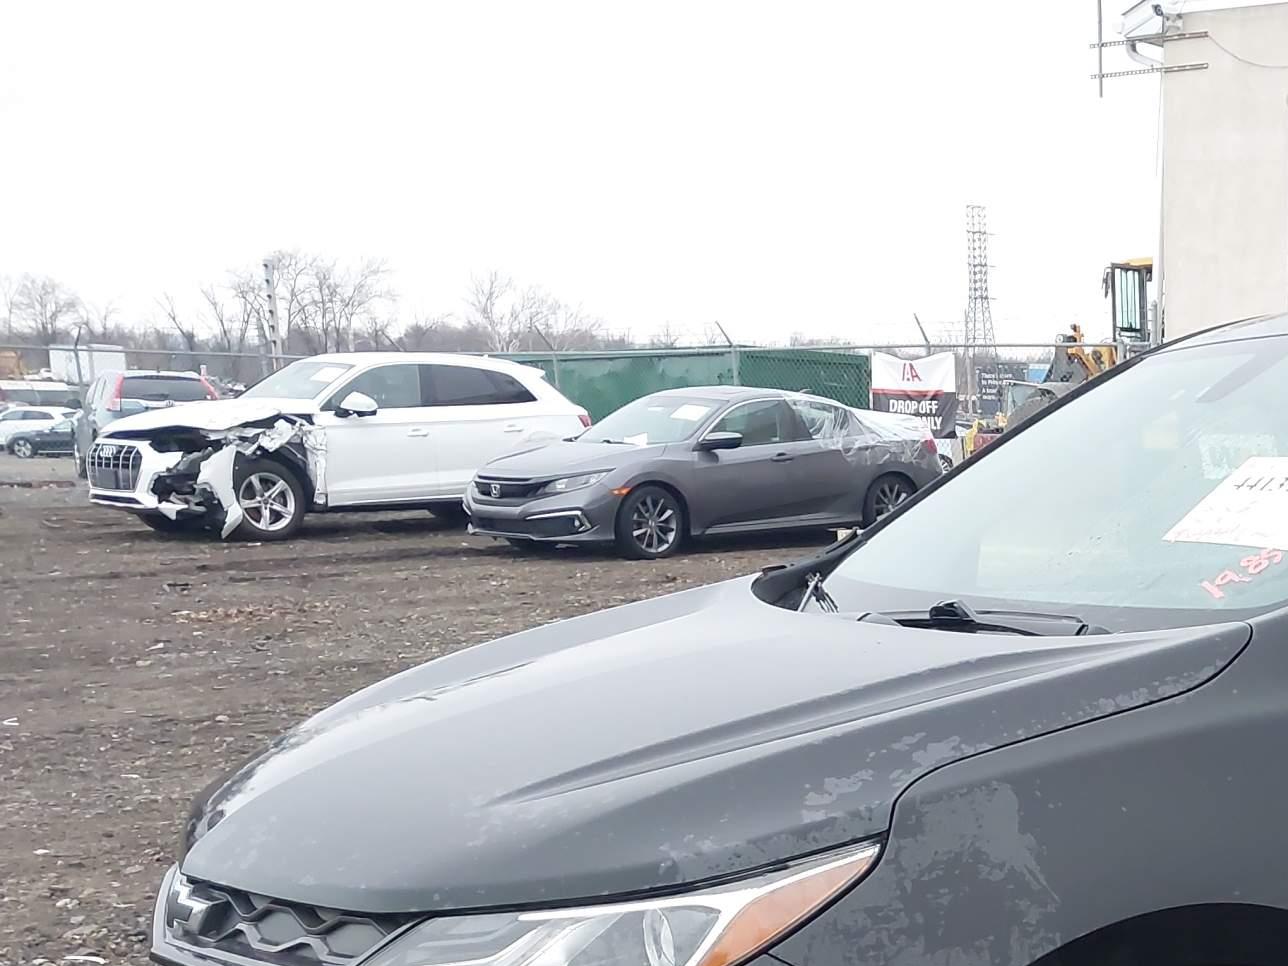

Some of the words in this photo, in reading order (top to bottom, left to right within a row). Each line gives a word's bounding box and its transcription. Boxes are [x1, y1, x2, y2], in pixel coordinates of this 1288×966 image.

[889, 399, 918, 414] DROP
[919, 400, 938, 414] OFF
[914, 416, 943, 430] NLY
